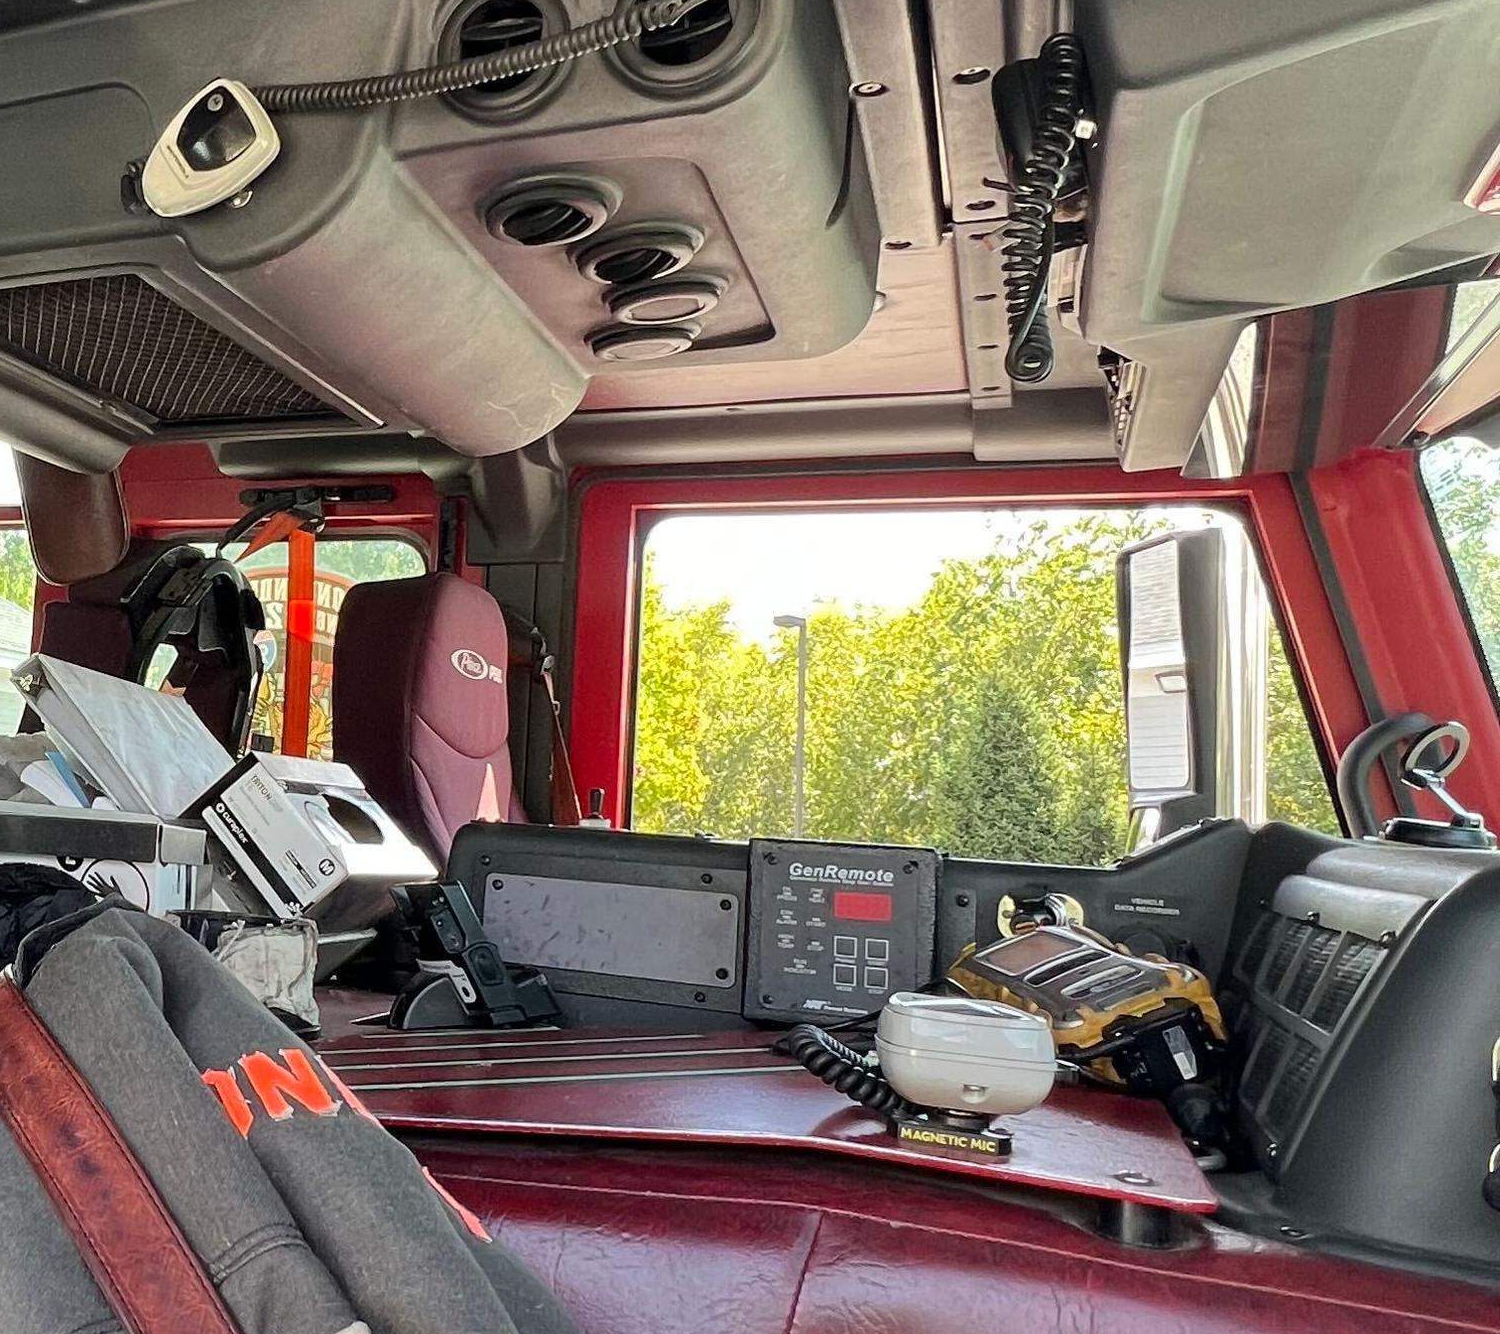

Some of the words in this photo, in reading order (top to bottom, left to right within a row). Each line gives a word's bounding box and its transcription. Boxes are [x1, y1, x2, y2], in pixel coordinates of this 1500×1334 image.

[222, 810, 249, 844] curaplex
[319, 860, 334, 875] M
[789, 862, 895, 883] GenRemote
[900, 1127, 969, 1148] MAGNETIC
[969, 1137, 997, 1153] MIC
